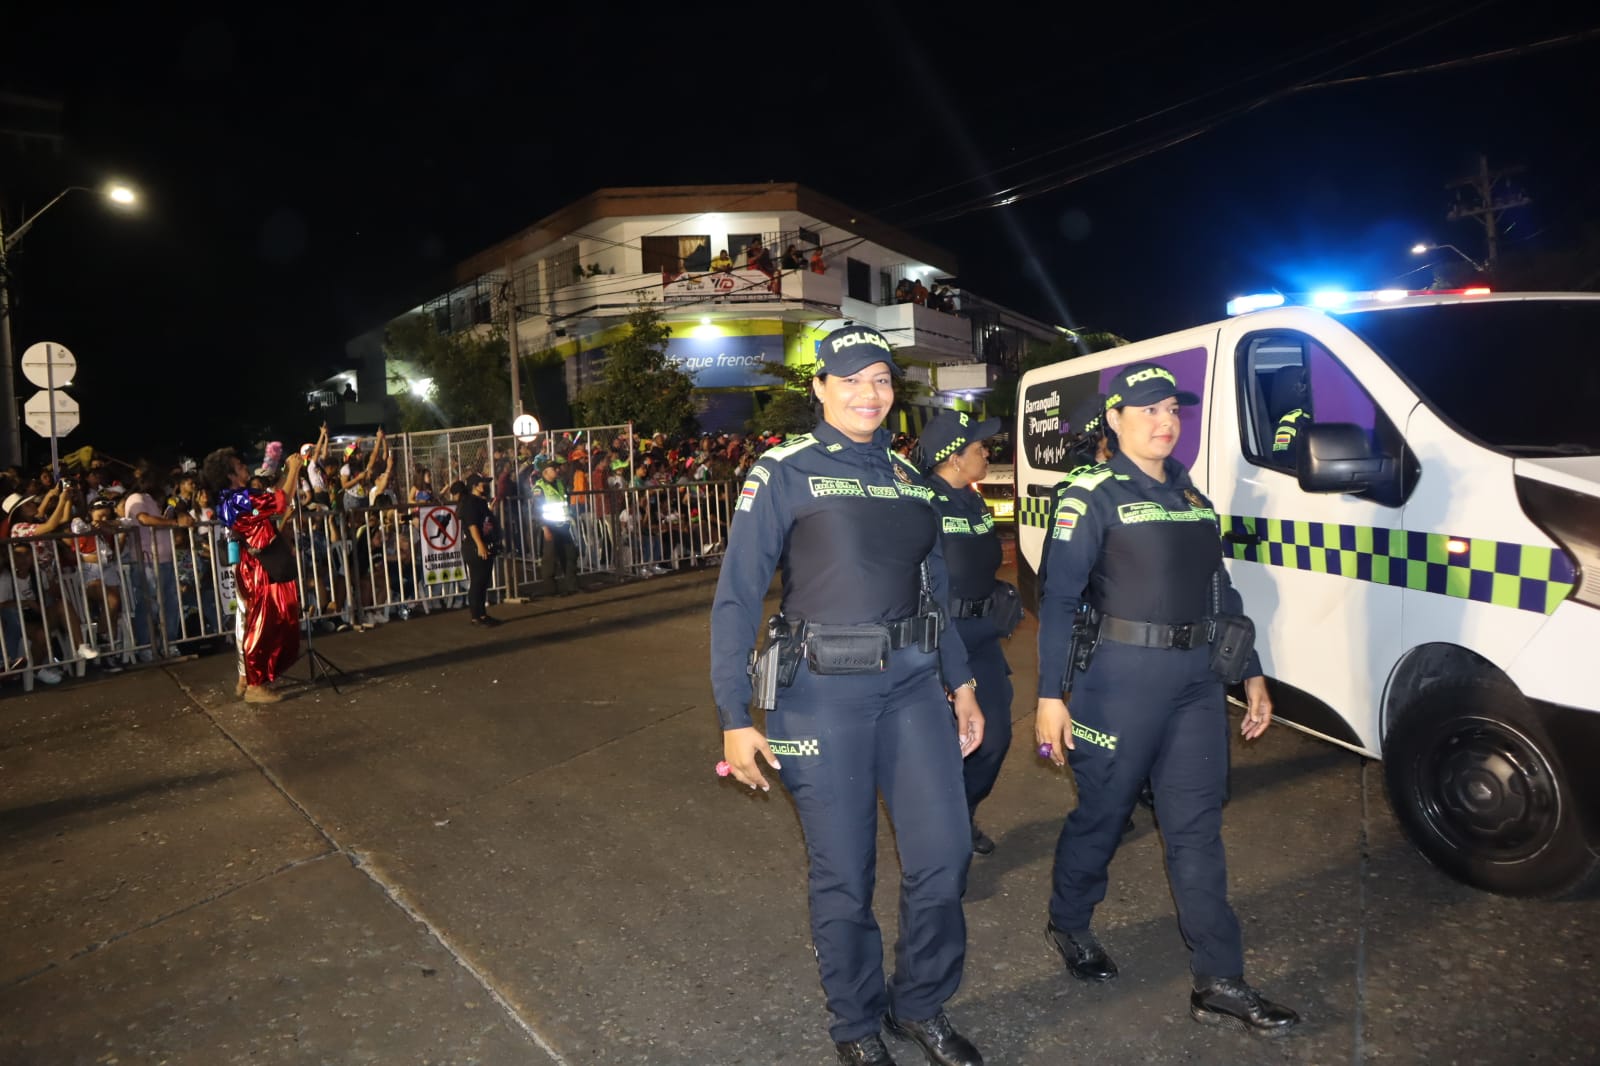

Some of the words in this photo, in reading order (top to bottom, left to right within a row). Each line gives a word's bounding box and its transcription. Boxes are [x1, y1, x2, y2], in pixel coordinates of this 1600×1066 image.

[686, 356, 713, 370] que
[1025, 391, 1060, 413] Barranquilla
[769, 743, 797, 753] OLICÍA
